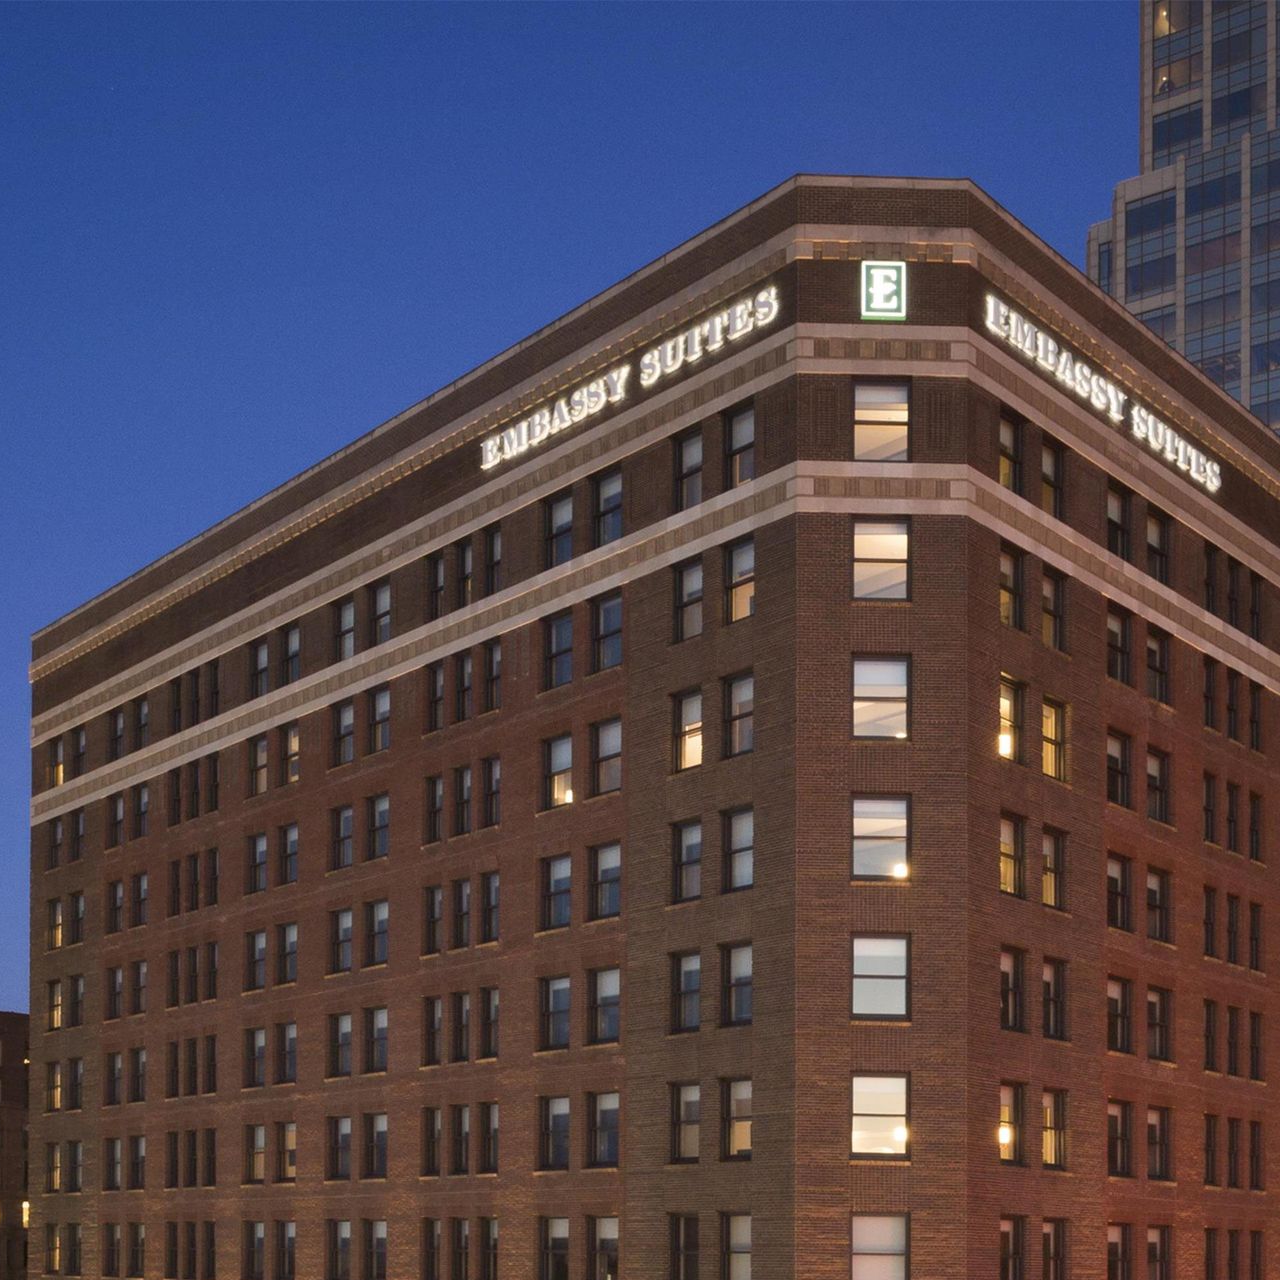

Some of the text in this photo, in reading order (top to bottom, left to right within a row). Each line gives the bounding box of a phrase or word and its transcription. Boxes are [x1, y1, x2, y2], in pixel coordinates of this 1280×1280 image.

[480, 286, 780, 470] EMBASSY SUITES
[868, 267, 898, 310] E
[985, 293, 1222, 494] EMBASSY SUITES
